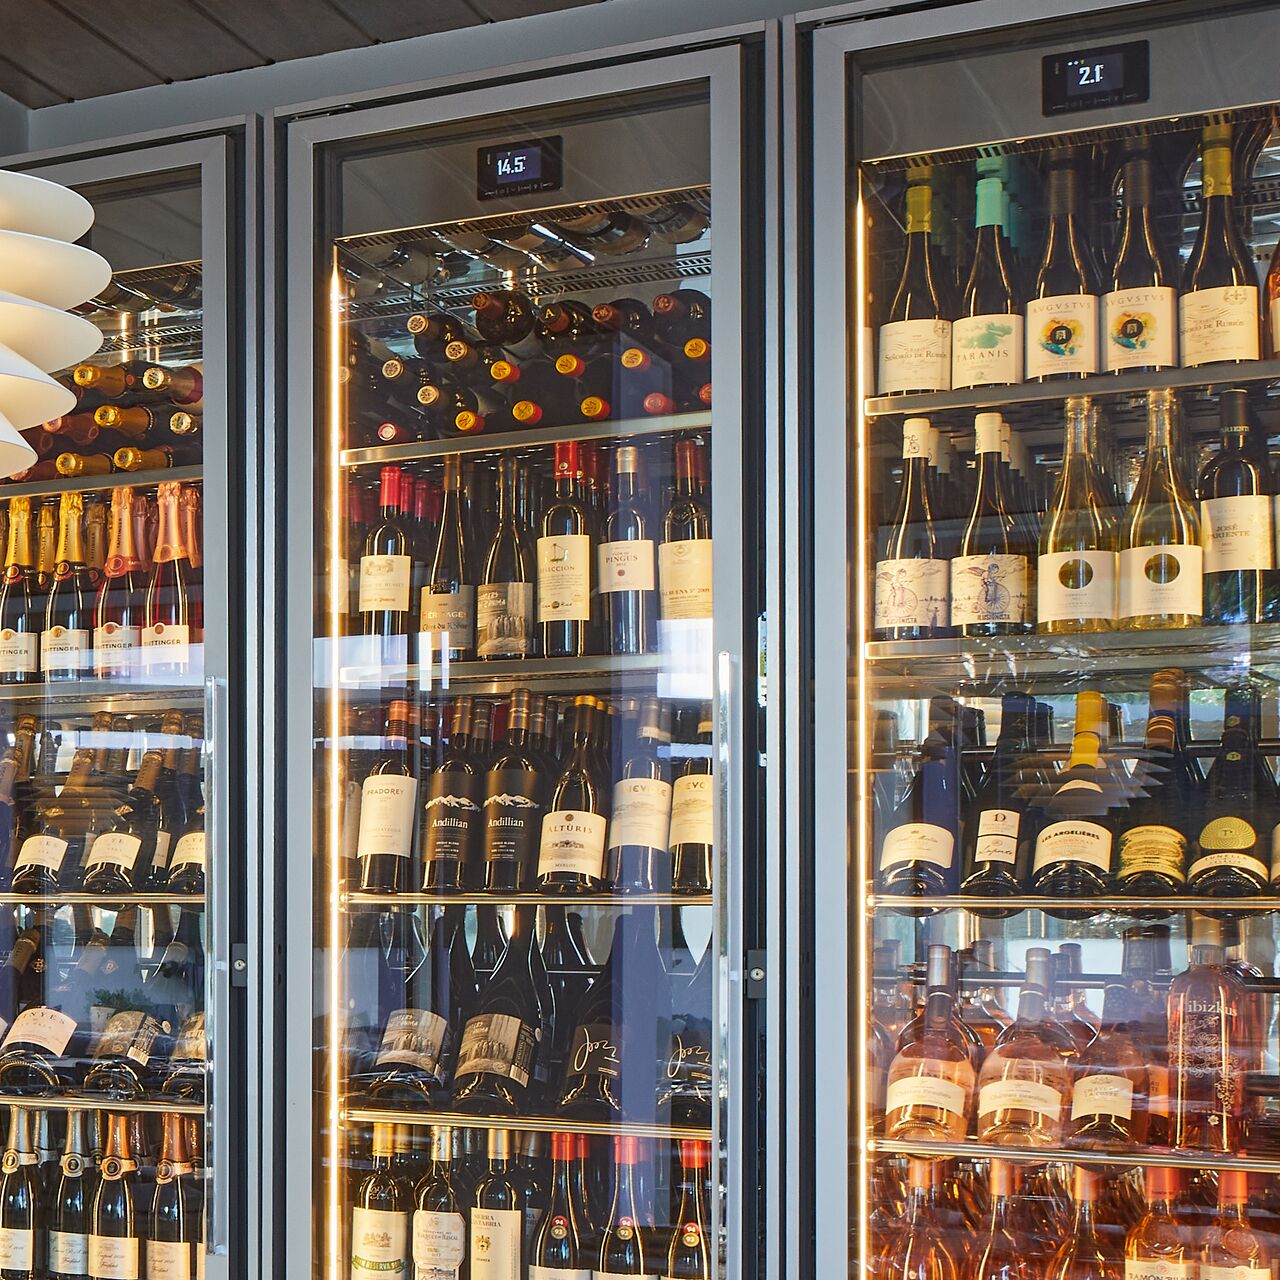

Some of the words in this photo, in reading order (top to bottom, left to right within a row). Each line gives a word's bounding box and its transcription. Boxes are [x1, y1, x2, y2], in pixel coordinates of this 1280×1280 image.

[605, 555, 639, 564] PINGUS
[41, 646, 80, 654] TAITTINGER
[95, 642, 133, 650] TAITTINGER
[431, 818, 469, 830] Andillian
[487, 816, 524, 829] Andillian
